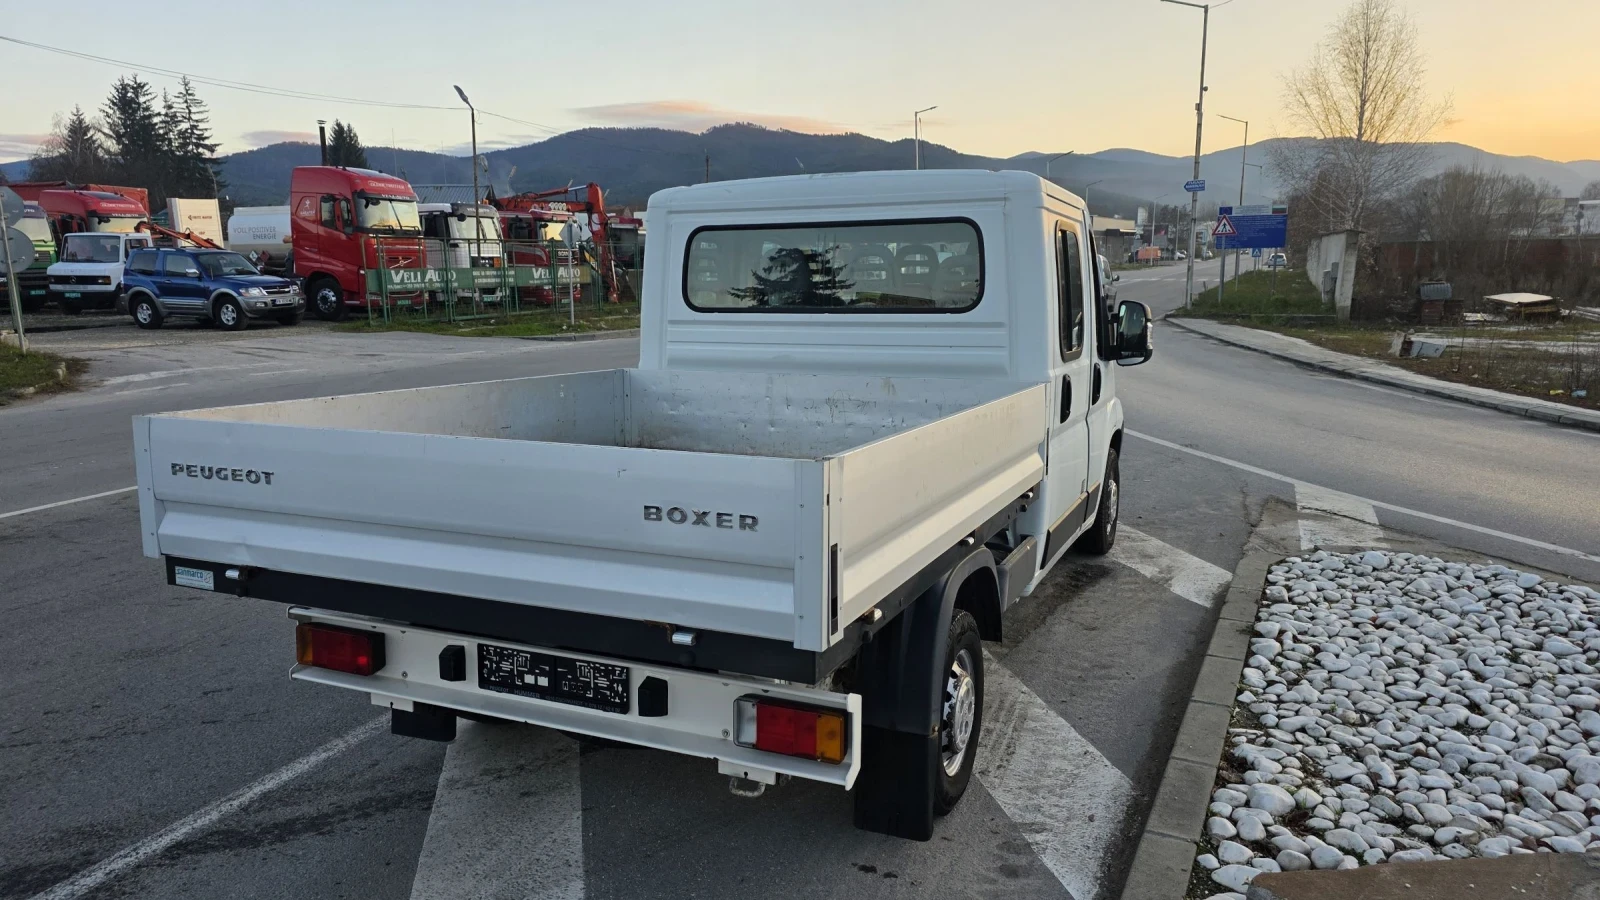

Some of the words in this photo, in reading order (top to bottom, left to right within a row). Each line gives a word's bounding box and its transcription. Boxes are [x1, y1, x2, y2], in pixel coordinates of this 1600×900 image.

[248, 226, 277, 234] POSITIVER
[252, 232, 277, 240] ENERGIE
[390, 269, 422, 283] VELI
[171, 462, 274, 485] PEUGEOT
[643, 505, 759, 532] BOXER
[176, 568, 204, 579] sanmarco
